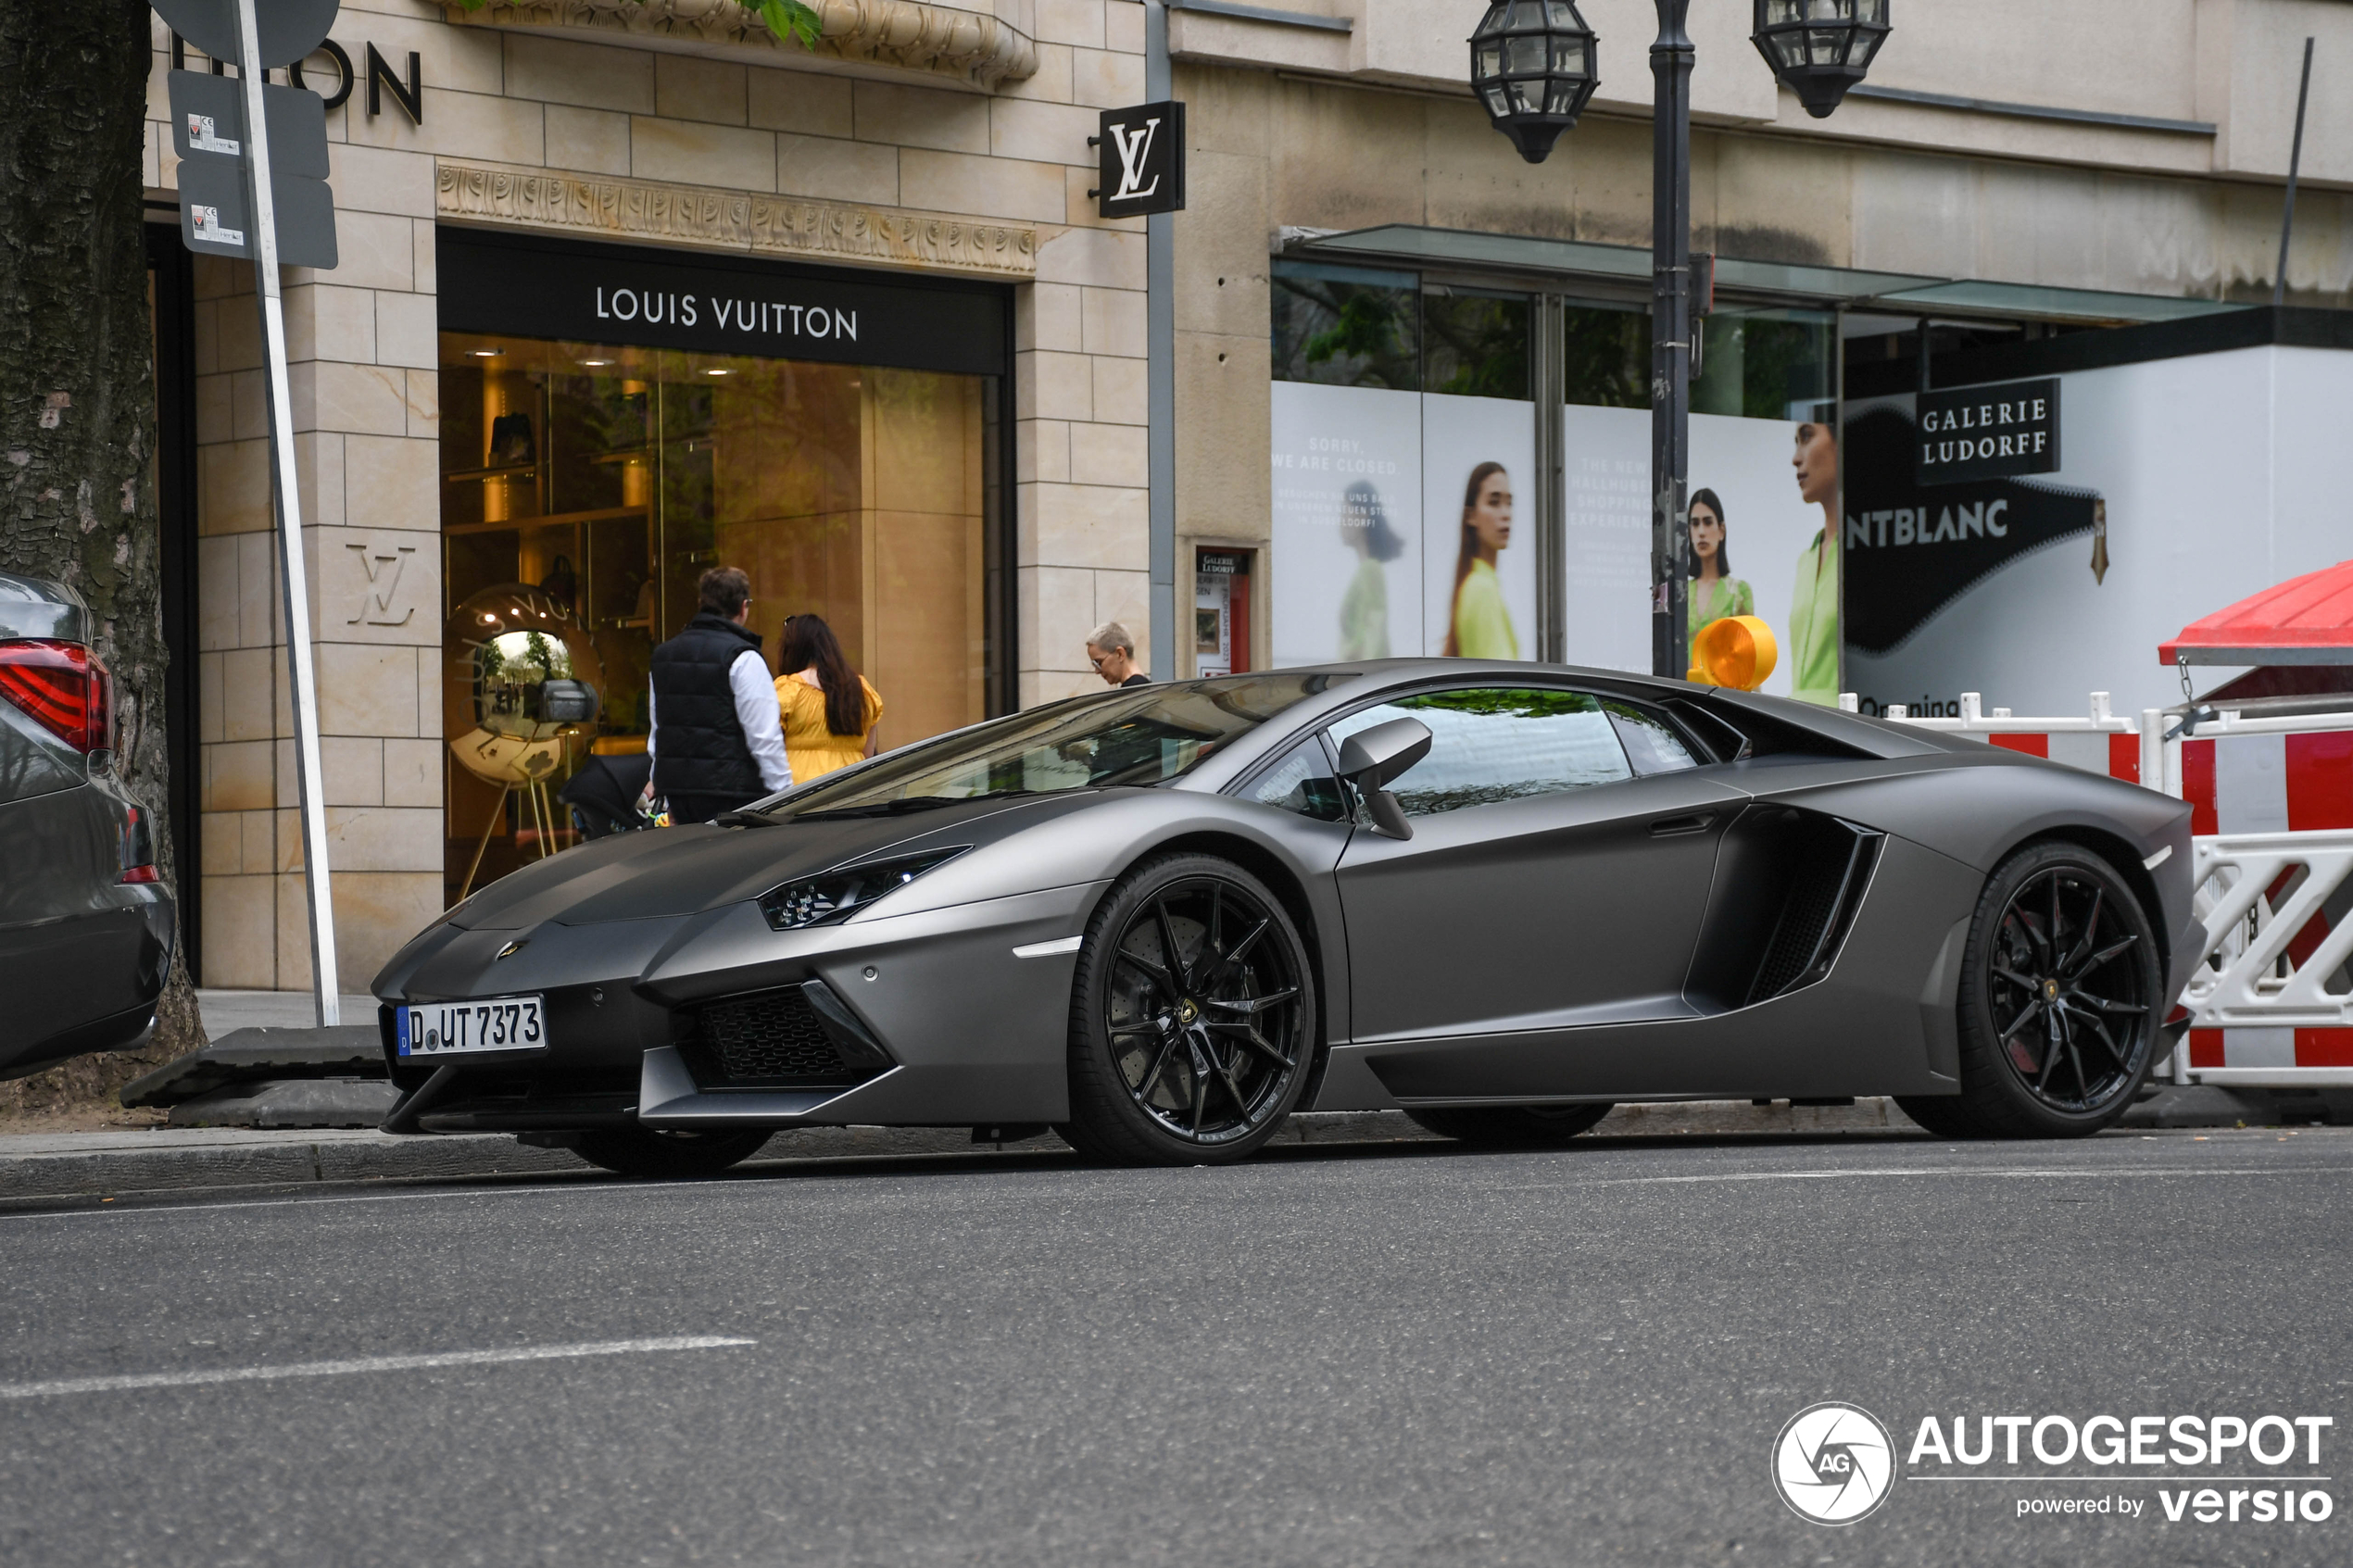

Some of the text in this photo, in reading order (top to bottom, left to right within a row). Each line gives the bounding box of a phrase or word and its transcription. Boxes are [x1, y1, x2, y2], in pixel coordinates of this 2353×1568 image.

[597, 287, 857, 342] LOUIS VUITTON
[1922, 398, 2047, 433] GALERIE
[1271, 454, 1294, 469] WE
[1300, 456, 1330, 470] ARE
[1922, 432, 2047, 465] LUDORFF
[1580, 458, 1647, 475] THE NEW
[1349, 493, 1369, 503] UNS
[410, 1002, 541, 1050] D UT 7373
